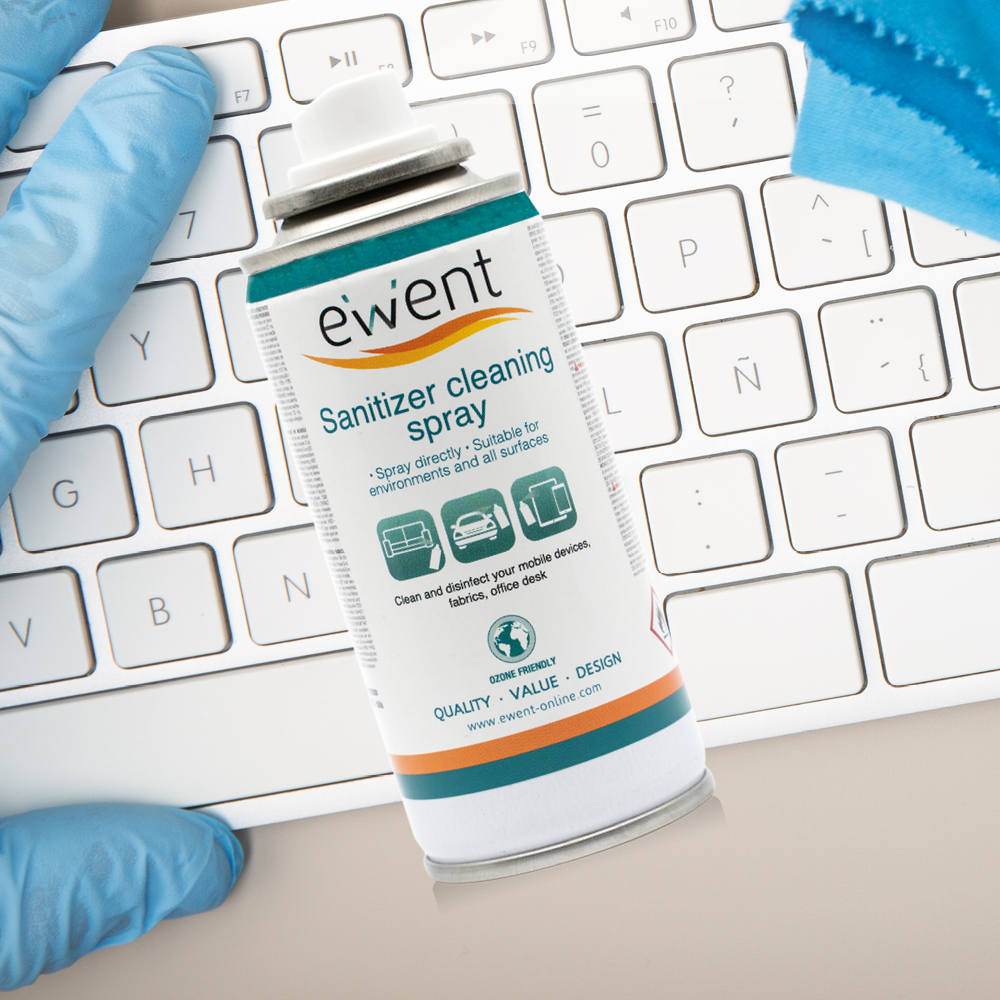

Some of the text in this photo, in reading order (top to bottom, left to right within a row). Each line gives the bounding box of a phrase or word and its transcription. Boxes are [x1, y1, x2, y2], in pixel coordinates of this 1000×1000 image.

[653, 15, 679, 31] F10
[520, 39, 537, 55] F9
[234, 89, 250, 104] F7
[178, 210, 197, 240] 7
[678, 238, 698, 269] P
[129, 330, 151, 361] Y
[319, 345, 555, 435] Sanitizer cleaning
[733, 355, 762, 395] Ñ
[601, 386, 623, 415] L
[406, 399, 487, 444] spray
[368, 432, 550, 497] environments and all surfaces
[375, 420, 540, 480] Spray directly Suitable for
[188, 454, 216, 486] H
[51, 479, 79, 509] G
[282, 572, 311, 603] N
[394, 539, 591, 606] Clean and disinfect your mobile devices,
[448, 570, 548, 608] fabrics, office desk
[148, 596, 171, 626] B
[8, 617, 32, 648] V
[488, 656, 557, 685] OZONE FRIENDLY
[433, 651, 623, 722] QUALITY VALUE DESIGN
[466, 681, 603, 732] www.ewent-online.com
